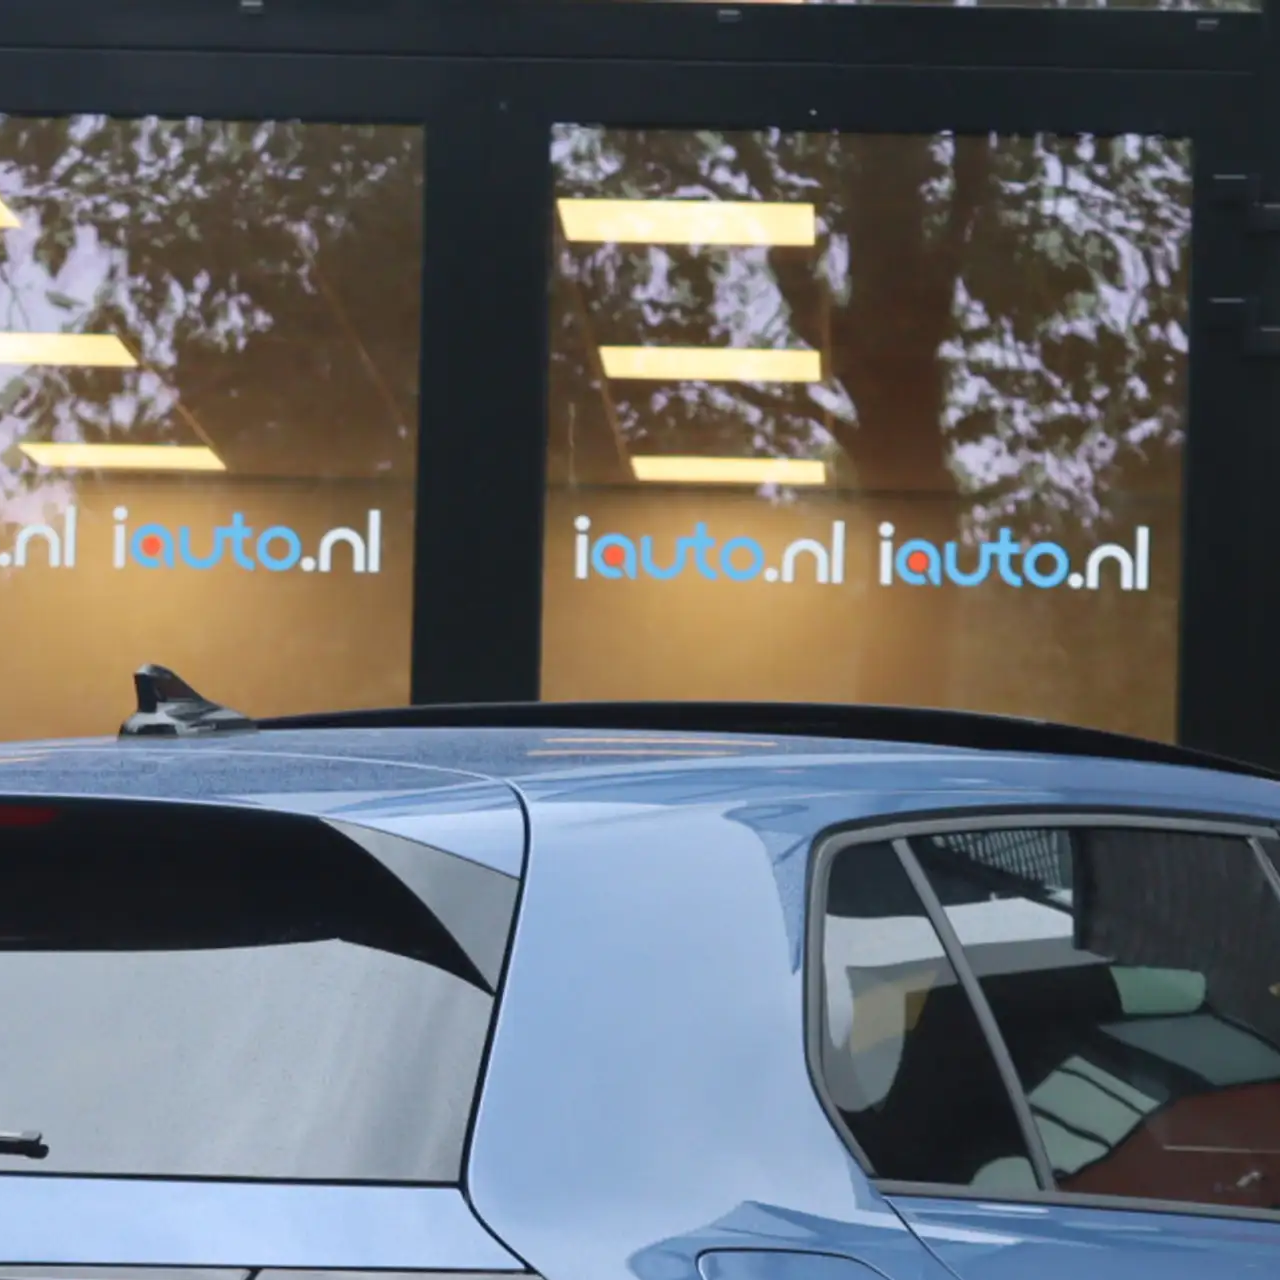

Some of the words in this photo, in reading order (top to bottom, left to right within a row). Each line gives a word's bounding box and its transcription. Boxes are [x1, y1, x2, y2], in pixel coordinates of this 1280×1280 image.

[113, 506, 380, 573] iauto.nl
[574, 515, 843, 583] iauto.nl
[880, 521, 1148, 590] iauto.nl
